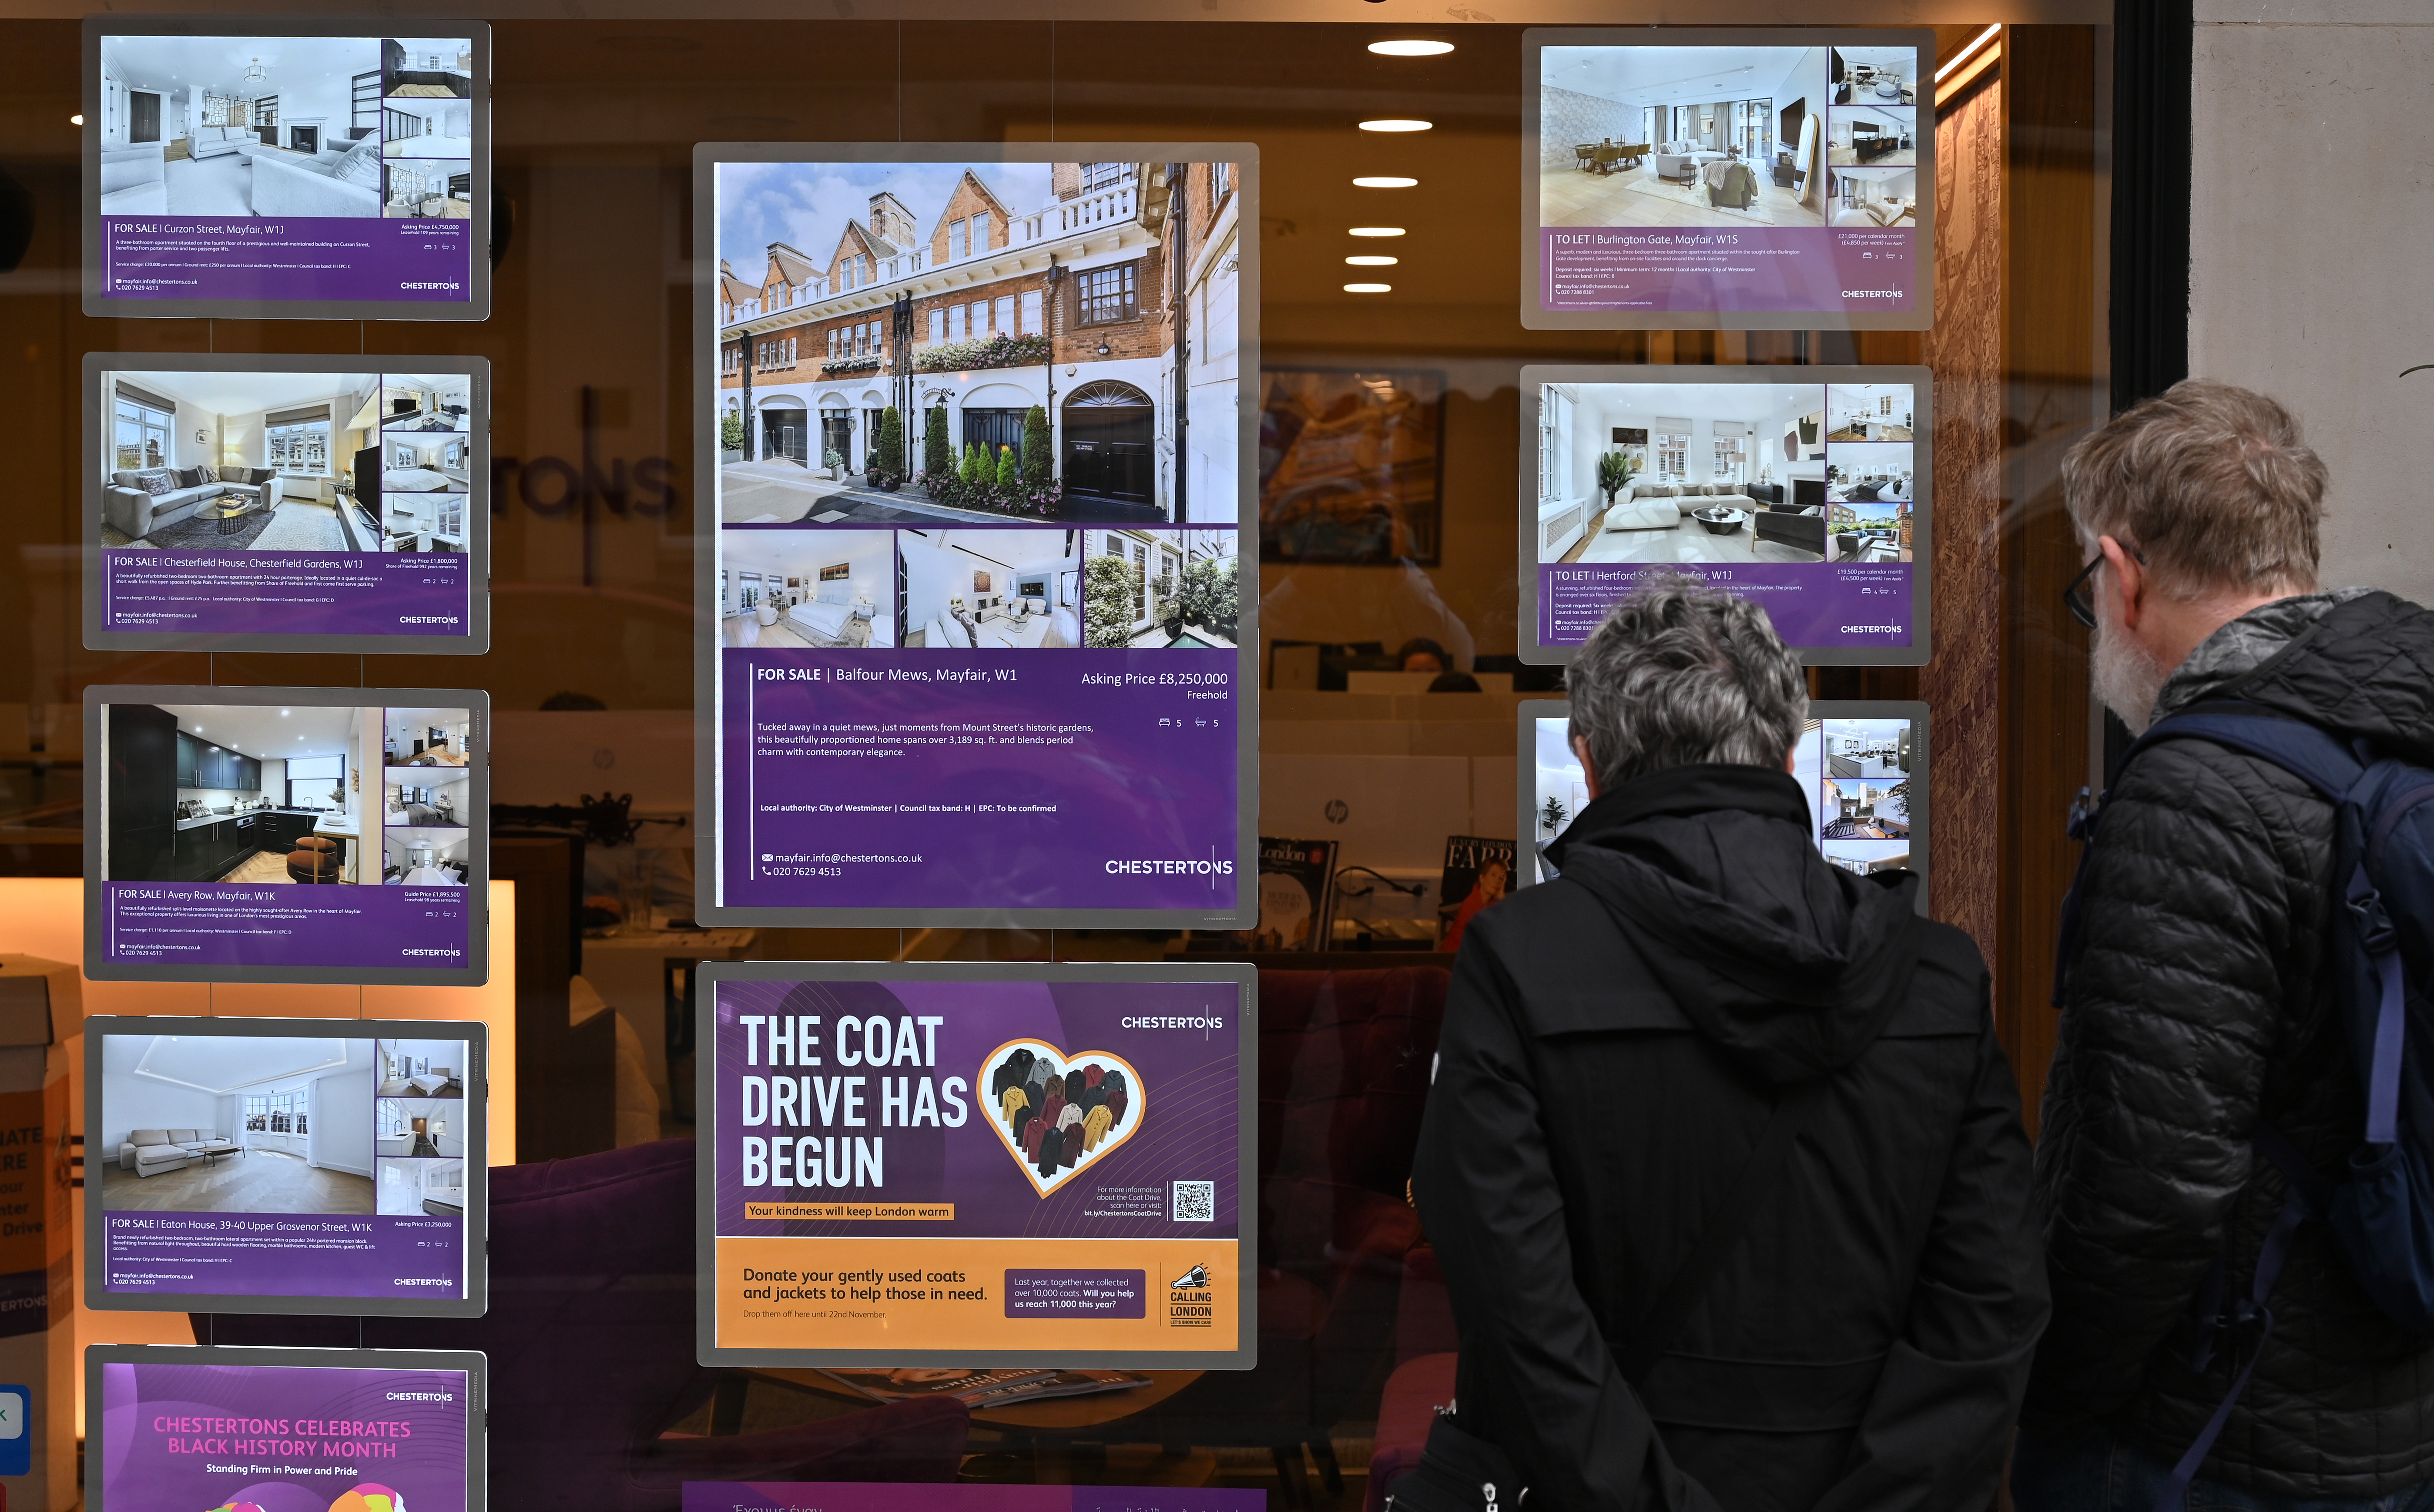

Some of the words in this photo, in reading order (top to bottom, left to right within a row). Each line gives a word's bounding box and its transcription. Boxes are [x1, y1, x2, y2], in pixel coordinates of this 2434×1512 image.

[115, 224, 133, 232] FOR
[136, 224, 158, 232] SALE
[164, 224, 194, 233] Curzon
[197, 225, 224, 234] Street,
[227, 225, 262, 236] Mayfair,
[265, 225, 283, 234] W1J
[1556, 235, 1570, 244] TO
[1573, 235, 1590, 244] LET
[1597, 235, 1645, 246] Burlington
[1648, 235, 1672, 245] Gate,
[1676, 235, 1713, 246] Mayfair,
[1716, 235, 1737, 244] W1S
[115, 557, 133, 566] FOR
[136, 557, 158, 566] SALE
[164, 557, 215, 567] Chesterfield
[218, 558, 247, 568] House,
[250, 558, 301, 568] Chesterfield
[304, 559, 341, 569] Gardens,
[343, 560, 362, 568] W1J
[1555, 571, 1569, 580] TO
[1572, 571, 1590, 580] LET
[1597, 570, 1636, 580] Hertford
[1639, 570, 1665, 580] Street
[1712, 570, 1733, 580] W1J
[758, 669, 785, 680] FOR
[789, 669, 821, 680] SALE
[837, 668, 884, 680] Balfour
[889, 669, 931, 682] Mews,
[937, 668, 990, 683] Mayfair,
[995, 669, 1017, 681] W1
[1081, 673, 1121, 686] Asking
[1126, 673, 1155, 684] Price
[1159, 673, 1227, 686] £8,250,000
[1187, 690, 1227, 699] Freehold
[1327, 799, 1348, 824] hp
[1105, 860, 1233, 874] CHESTERTONS
[119, 889, 137, 898] FOR
[139, 890, 161, 898] SALE
[168, 890, 192, 901] Avery
[194, 891, 214, 900] Row,
[217, 891, 252, 902] Mayfair,
[254, 892, 275, 900] W1K
[1122, 1017, 1222, 1028] CHESTERTONS
[740, 1015, 821, 1066] THE
[837, 1015, 943, 1066] COAT
[743, 1076, 865, 1126] DRIVE
[882, 1076, 967, 1127] HAS
[743, 1136, 882, 1187] BEGUN
[0, 1181, 23, 1195] our
[749, 1206, 773, 1215] Your
[776, 1206, 822, 1215] kindness
[825, 1206, 843, 1216] will
[847, 1206, 872, 1218] keep
[875, 1206, 915, 1216] London
[3, 1221, 44, 1237] Drive
[112, 1219, 130, 1227] FOR
[133, 1219, 154, 1228] SALE
[161, 1220, 186, 1228] Eaton
[189, 1220, 217, 1230] House,
[220, 1220, 245, 1229] 39-40
[248, 1221, 274, 1232] Upper
[276, 1222, 319, 1230] Grosvenor
[322, 1222, 349, 1232] Street,
[352, 1223, 372, 1231] W1K
[744, 1268, 797, 1281] Donate
[801, 1272, 834, 1285] your
[838, 1268, 883, 1285] gently
[888, 1269, 921, 1282] used
[926, 1271, 965, 1282] coats
[743, 1286, 770, 1298] and
[774, 1286, 826, 1302] jackets
[830, 1287, 845, 1299] to
[851, 1286, 881, 1303] help
[885, 1286, 925, 1299] those
[931, 1287, 942, 1300] in
[948, 1287, 987, 1300] need.
[1170, 1292, 1211, 1301] CALLING
[743, 1310, 760, 1319] Drop
[1170, 1307, 1211, 1316] LONDON
[386, 1392, 452, 1401] CHESTERTONS
[154, 1416, 289, 1435] CHESTERTONS
[295, 1419, 410, 1437] CELEBRATES
[169, 1438, 228, 1454] BLACK
[235, 1439, 317, 1456] HISTORY
[324, 1441, 395, 1458] MONTH
[207, 1464, 248, 1475] Standing
[251, 1465, 271, 1473] Firm
[273, 1465, 282, 1474] in
[285, 1465, 312, 1474] Power
[314, 1466, 332, 1475] and
[335, 1466, 358, 1475] Pride
